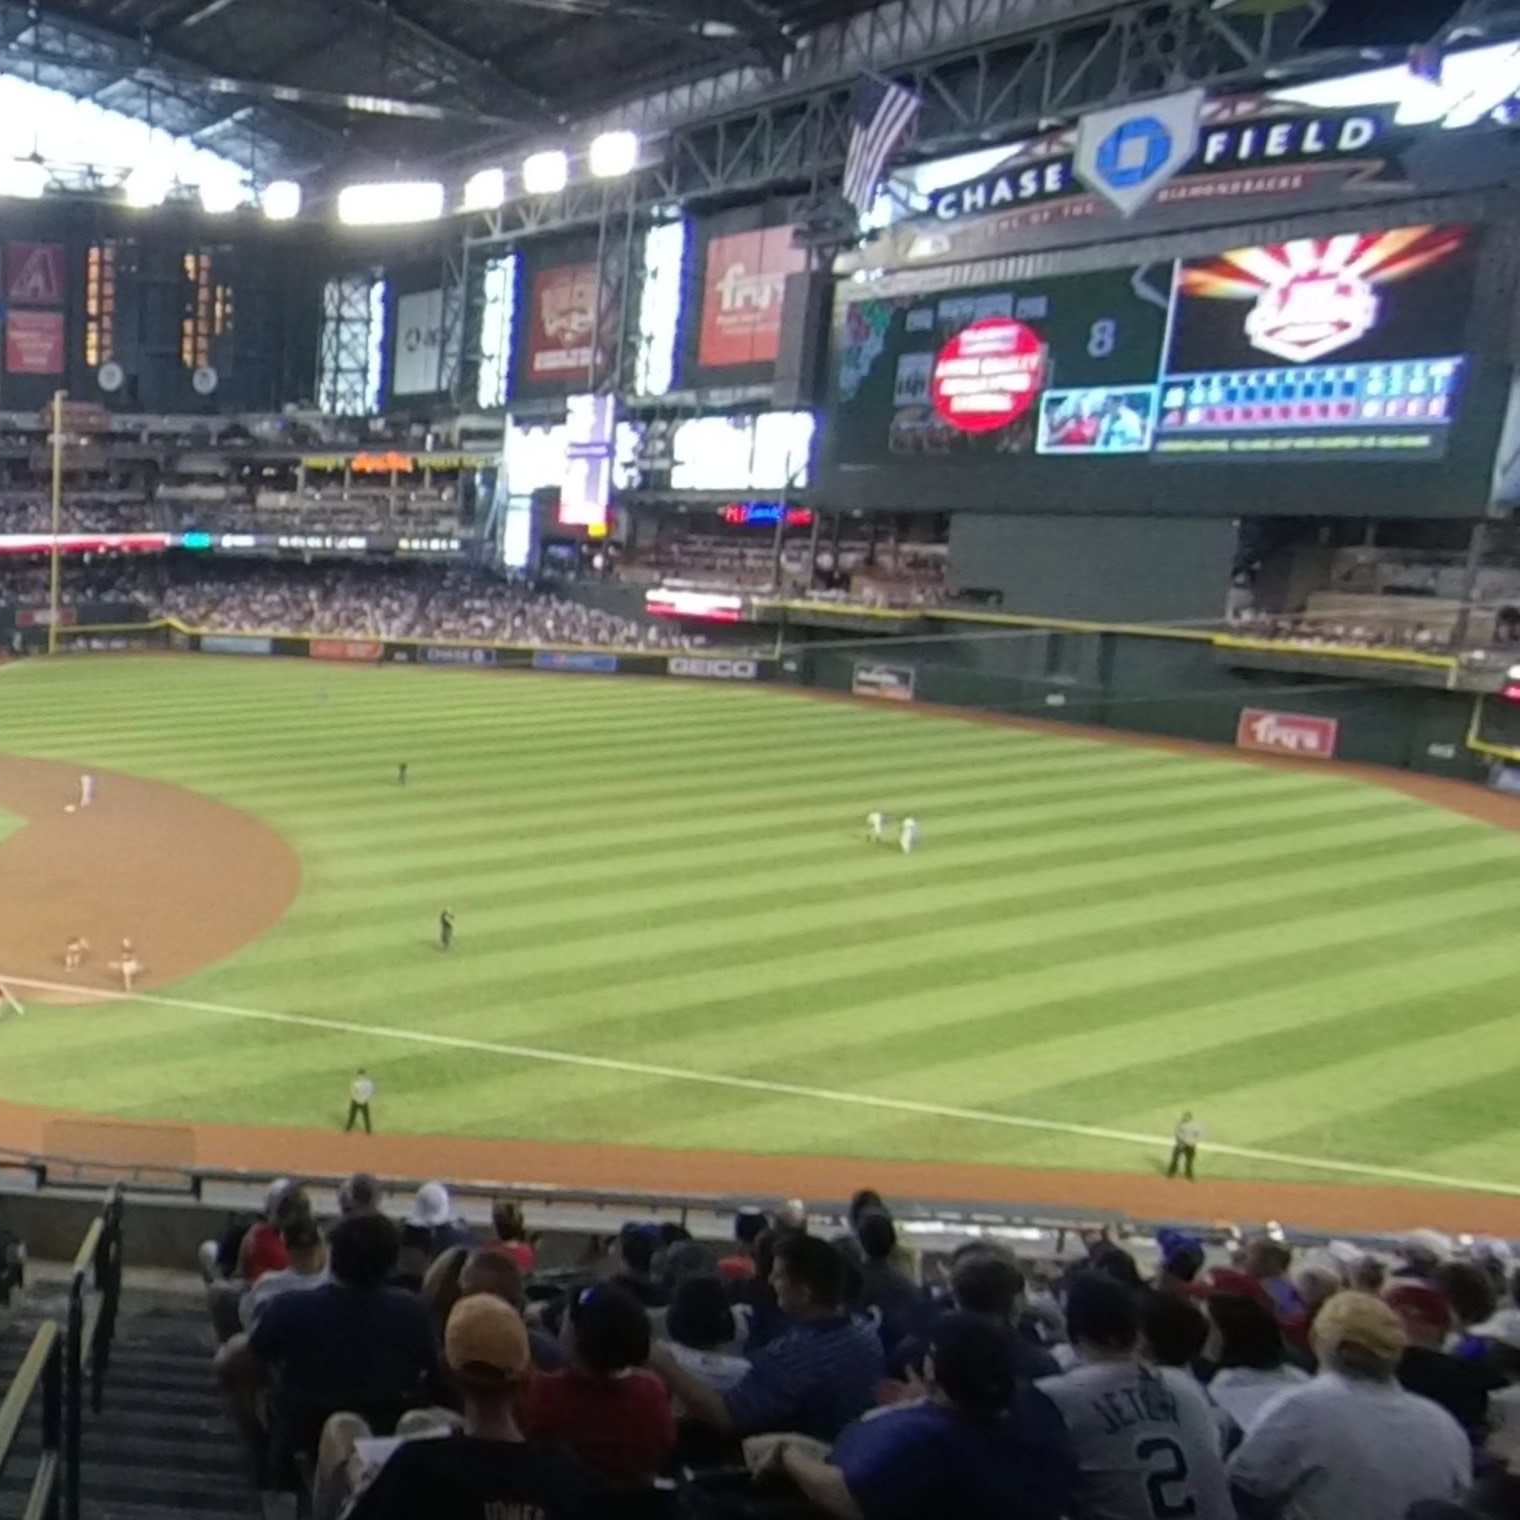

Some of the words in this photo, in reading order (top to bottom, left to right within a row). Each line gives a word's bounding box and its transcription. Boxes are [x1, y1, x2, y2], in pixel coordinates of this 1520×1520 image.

[937, 163, 1063, 220] CHASE
[1204, 117, 1375, 164] FIELD
[1088, 319, 1115, 357] 8
[668, 657, 757, 678] GEICO
[1135, 1436, 1196, 1520] 2
